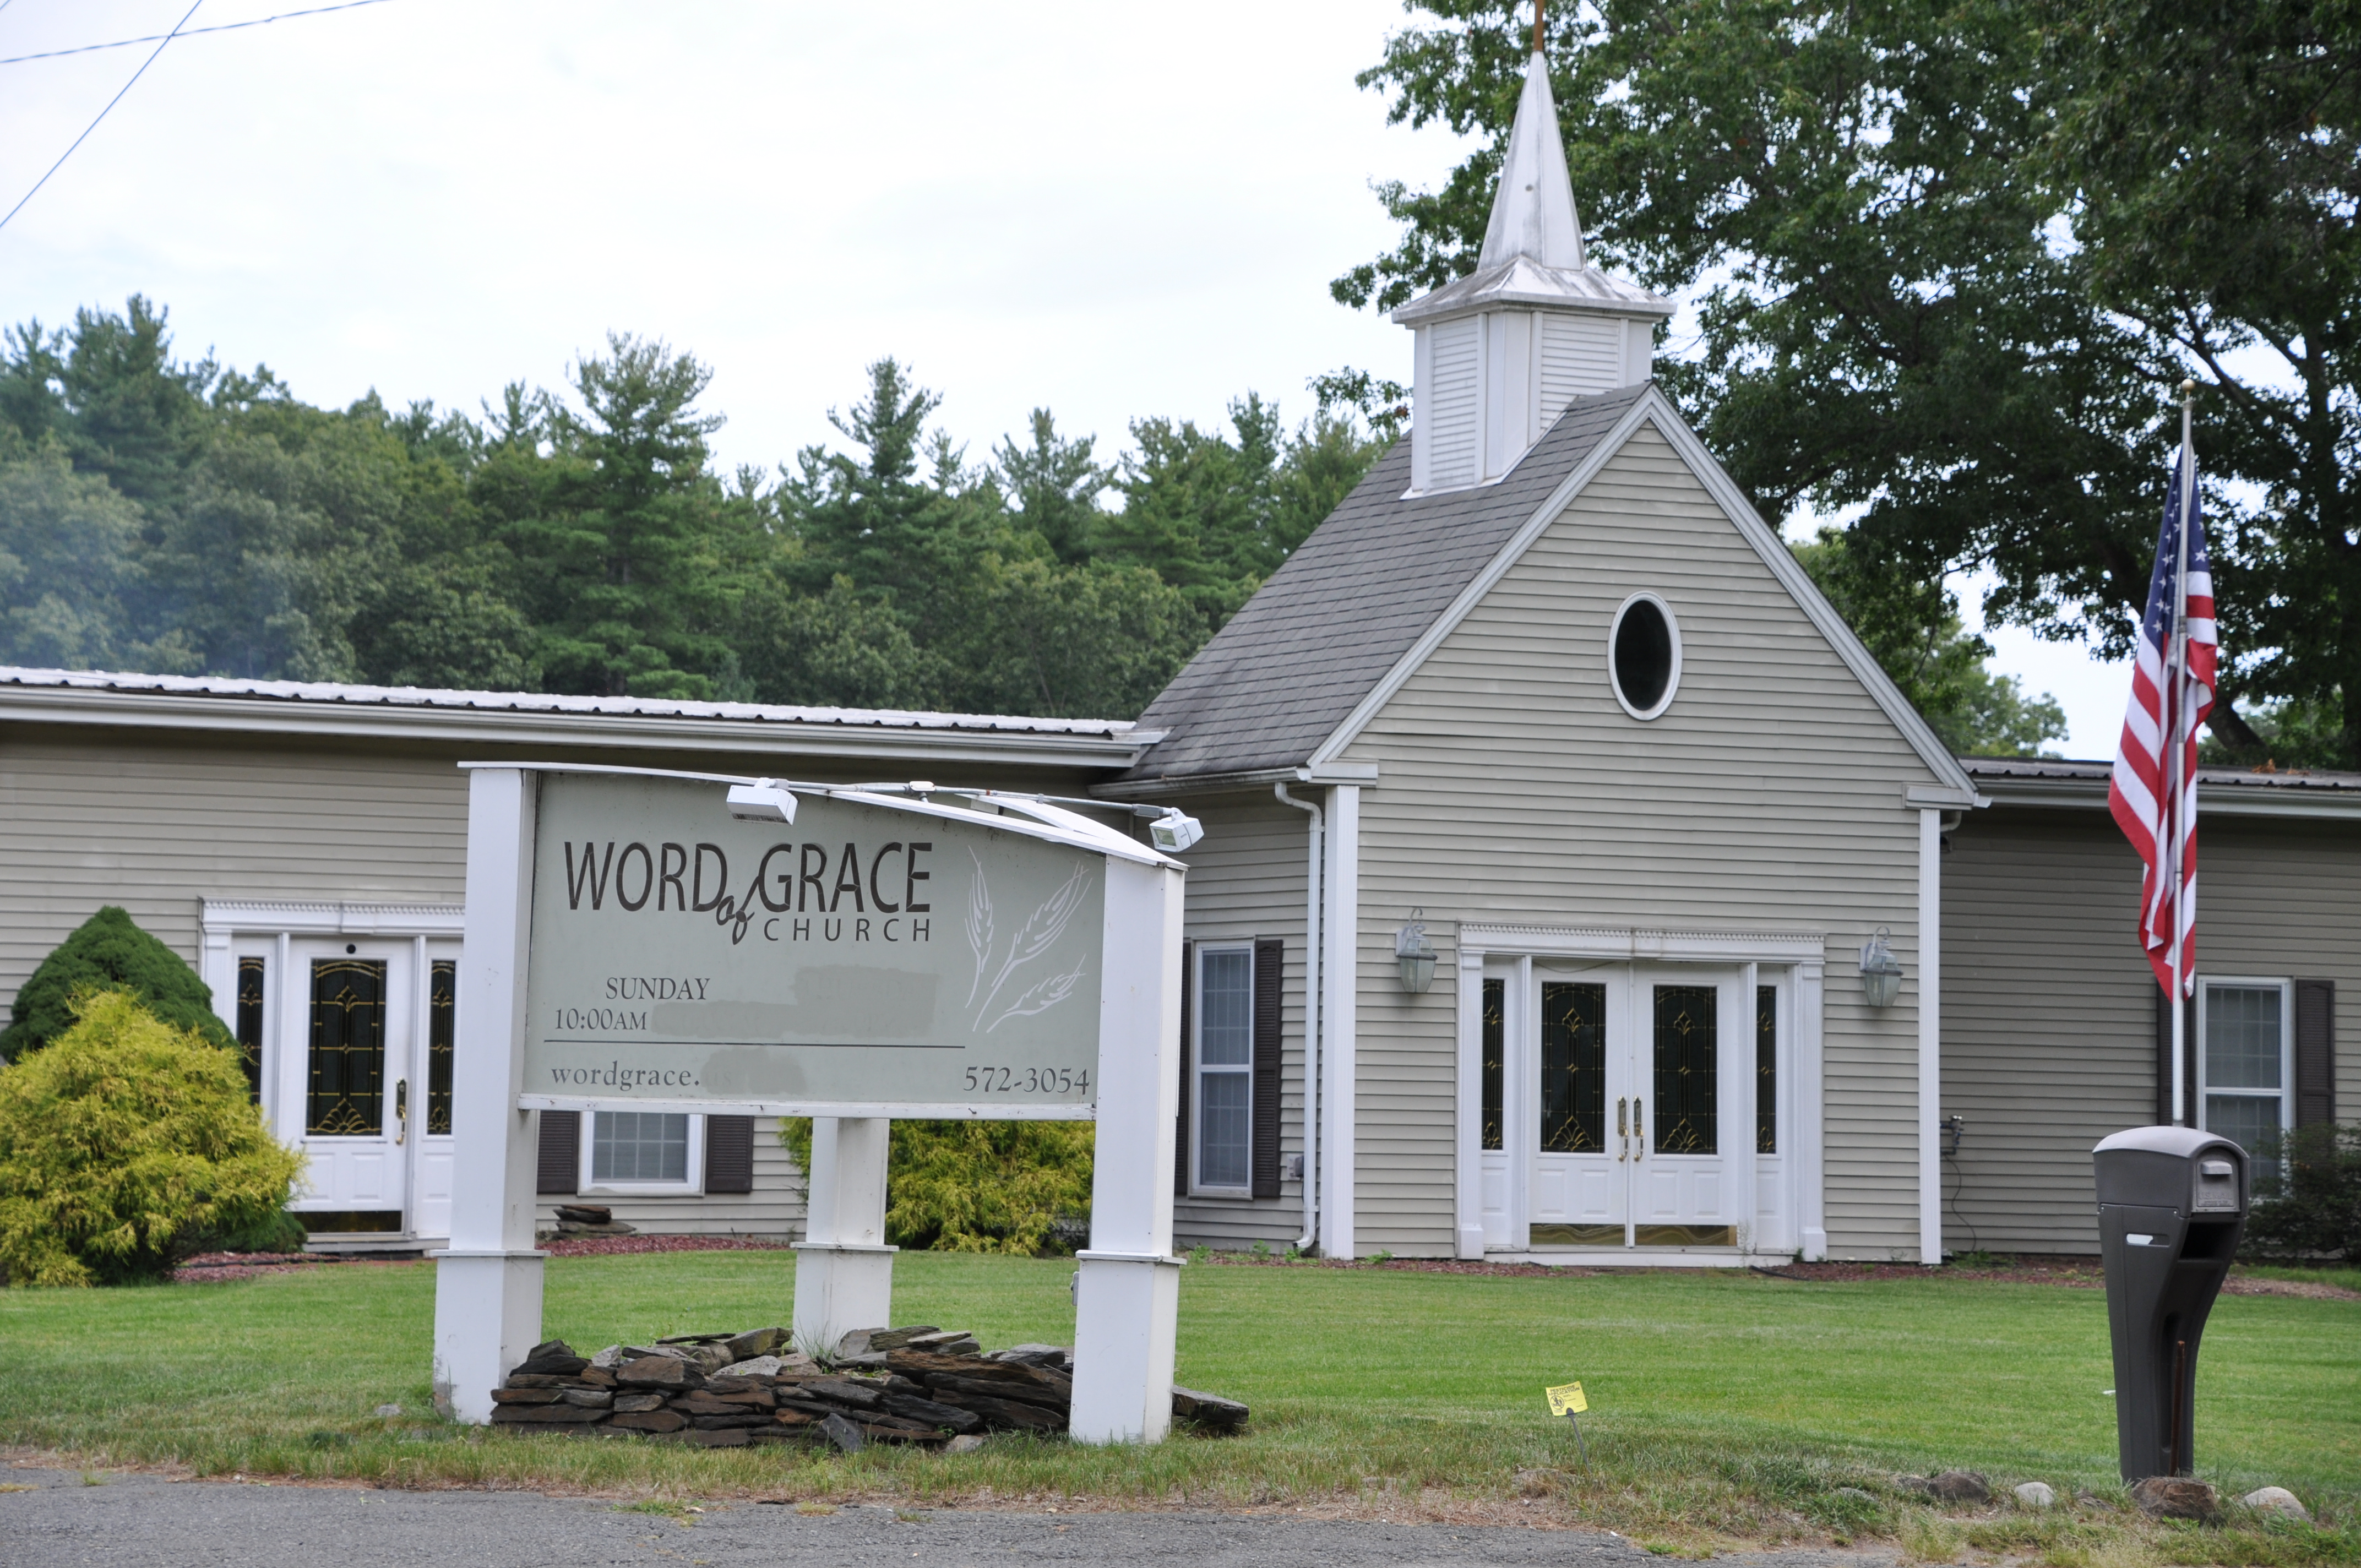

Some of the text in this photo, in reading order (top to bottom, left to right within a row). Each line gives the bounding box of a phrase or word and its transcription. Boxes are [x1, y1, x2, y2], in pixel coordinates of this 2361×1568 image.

[564, 841, 933, 945] WORD of GRACE
[764, 918, 930, 942] CHURCH
[605, 977, 711, 1000] SUNDAY
[554, 1008, 648, 1031] 10:00AM
[964, 1066, 1090, 1095] 572-3054
[1548, 1387, 1580, 1396] APPLICATION
